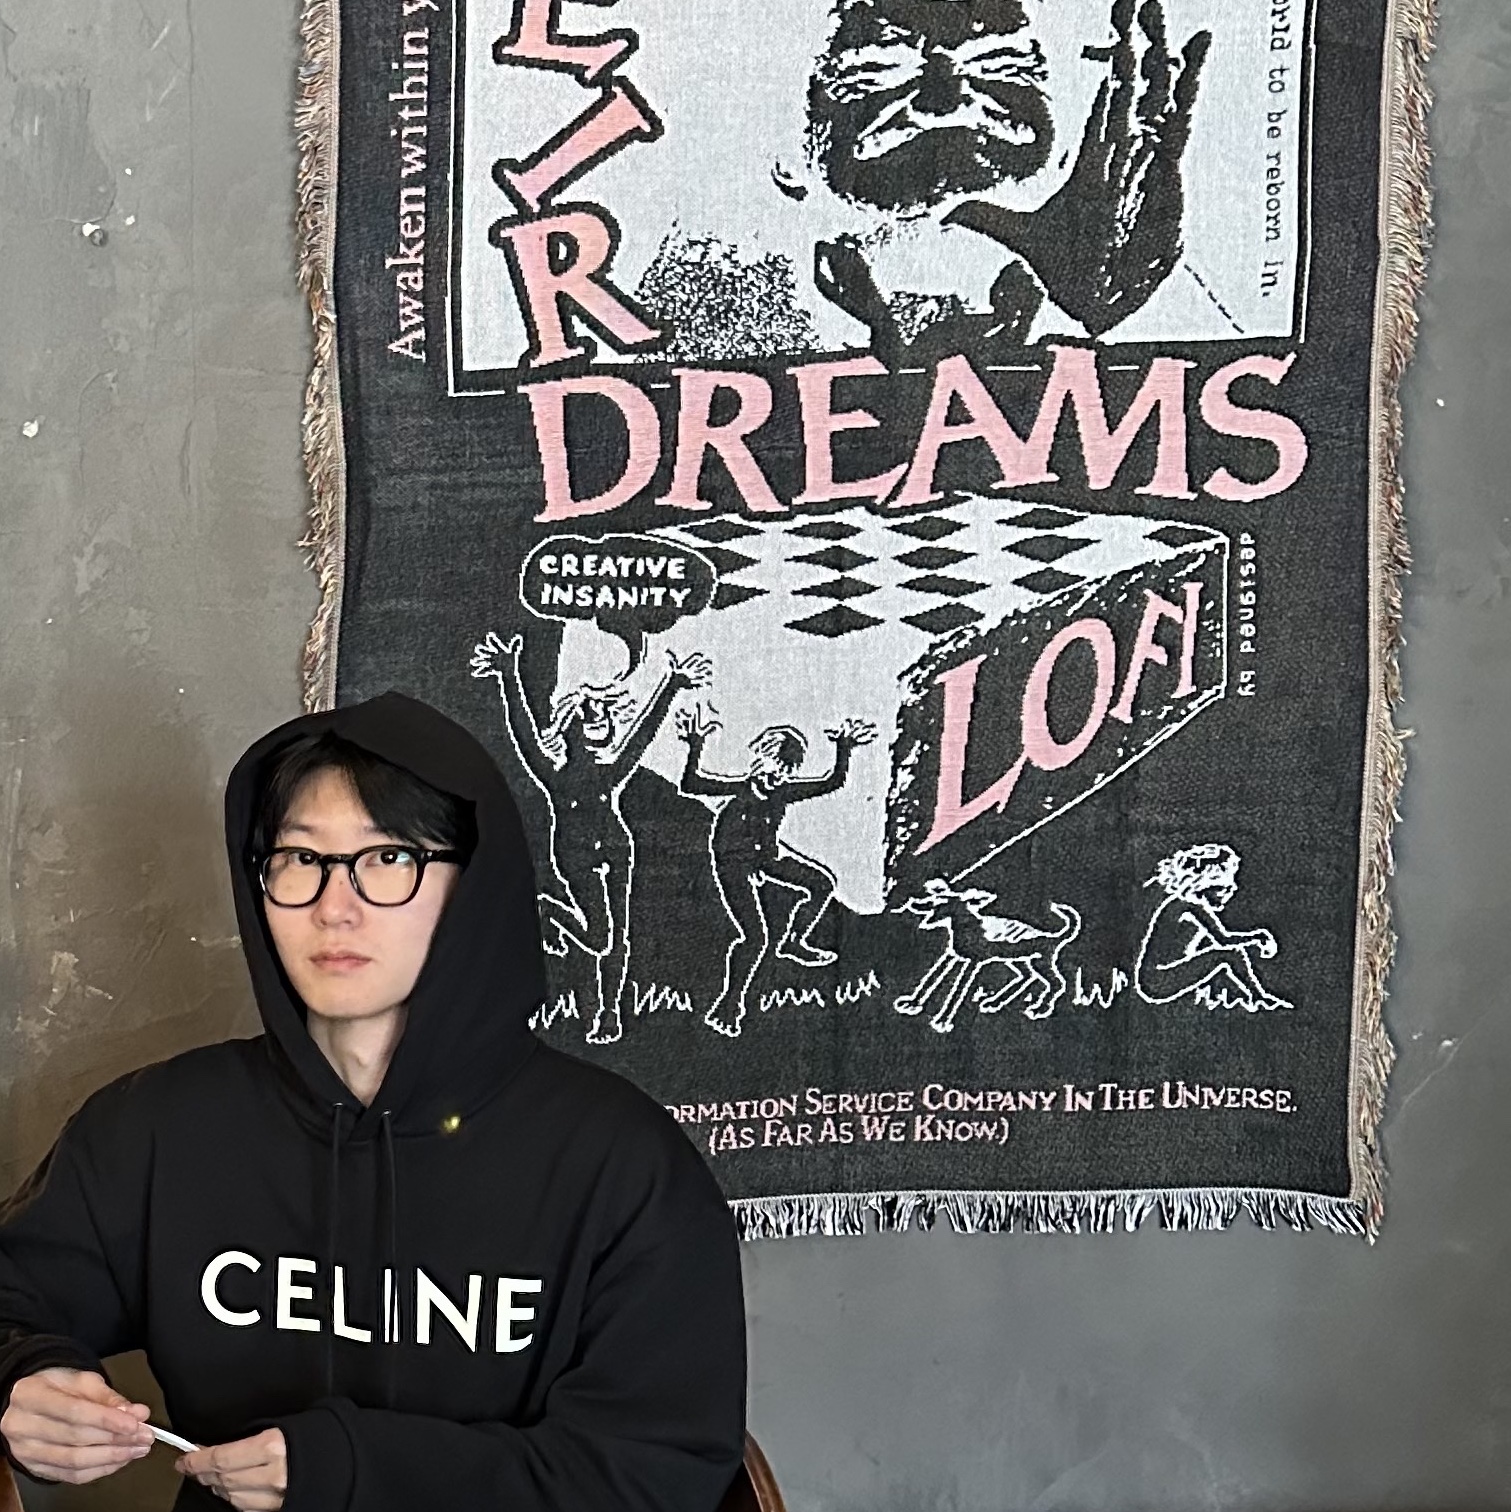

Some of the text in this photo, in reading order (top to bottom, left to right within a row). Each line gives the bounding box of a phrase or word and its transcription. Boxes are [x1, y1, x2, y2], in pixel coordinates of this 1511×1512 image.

[389, 27, 430, 178] within
[1268, 65, 1289, 93] to
[1267, 109, 1288, 139] be
[1265, 151, 1285, 242] reborn
[385, 187, 427, 363] Awaken
[518, 346, 1308, 523] DREAMS
[539, 553, 686, 580] CREATIVE
[541, 583, 692, 610] INSANITY
[1237, 532, 1256, 696] designed by
[804, 1086, 914, 1115] SERVICE
[922, 1083, 1057, 1113] COMPANY
[1063, 1084, 1095, 1112] IN
[1099, 1083, 1155, 1111] THE
[761, 1118, 814, 1147] FAR
[818, 1117, 854, 1144] AS
[860, 1114, 906, 1142] WE
[200, 1250, 544, 1354] CELINE
